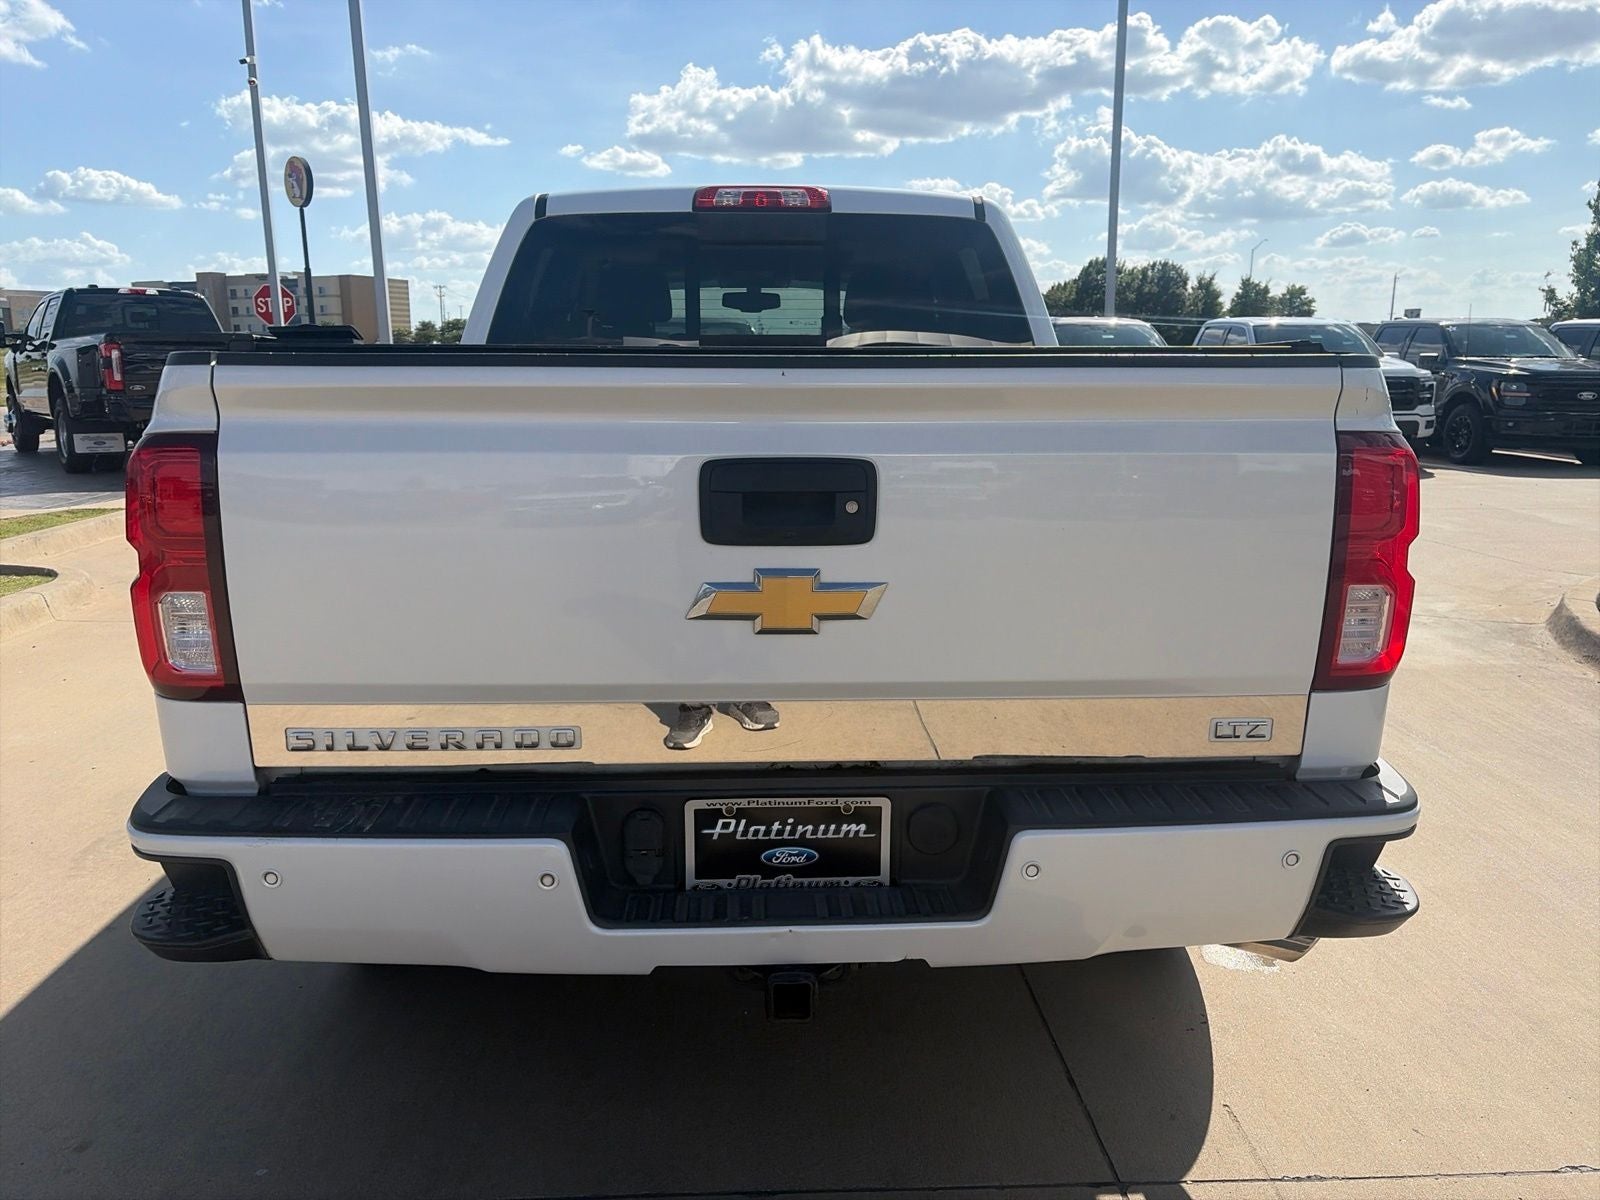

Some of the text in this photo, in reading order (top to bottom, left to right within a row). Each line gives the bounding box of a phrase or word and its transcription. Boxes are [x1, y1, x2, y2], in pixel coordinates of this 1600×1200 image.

[256, 297, 292, 313] STP
[1214, 720, 1268, 739] LTZ
[288, 728, 577, 751] SILVERADO
[706, 799, 872, 807] www.PlatinumFord.com
[701, 818, 877, 840] Platinum
[771, 848, 808, 865] Ford
